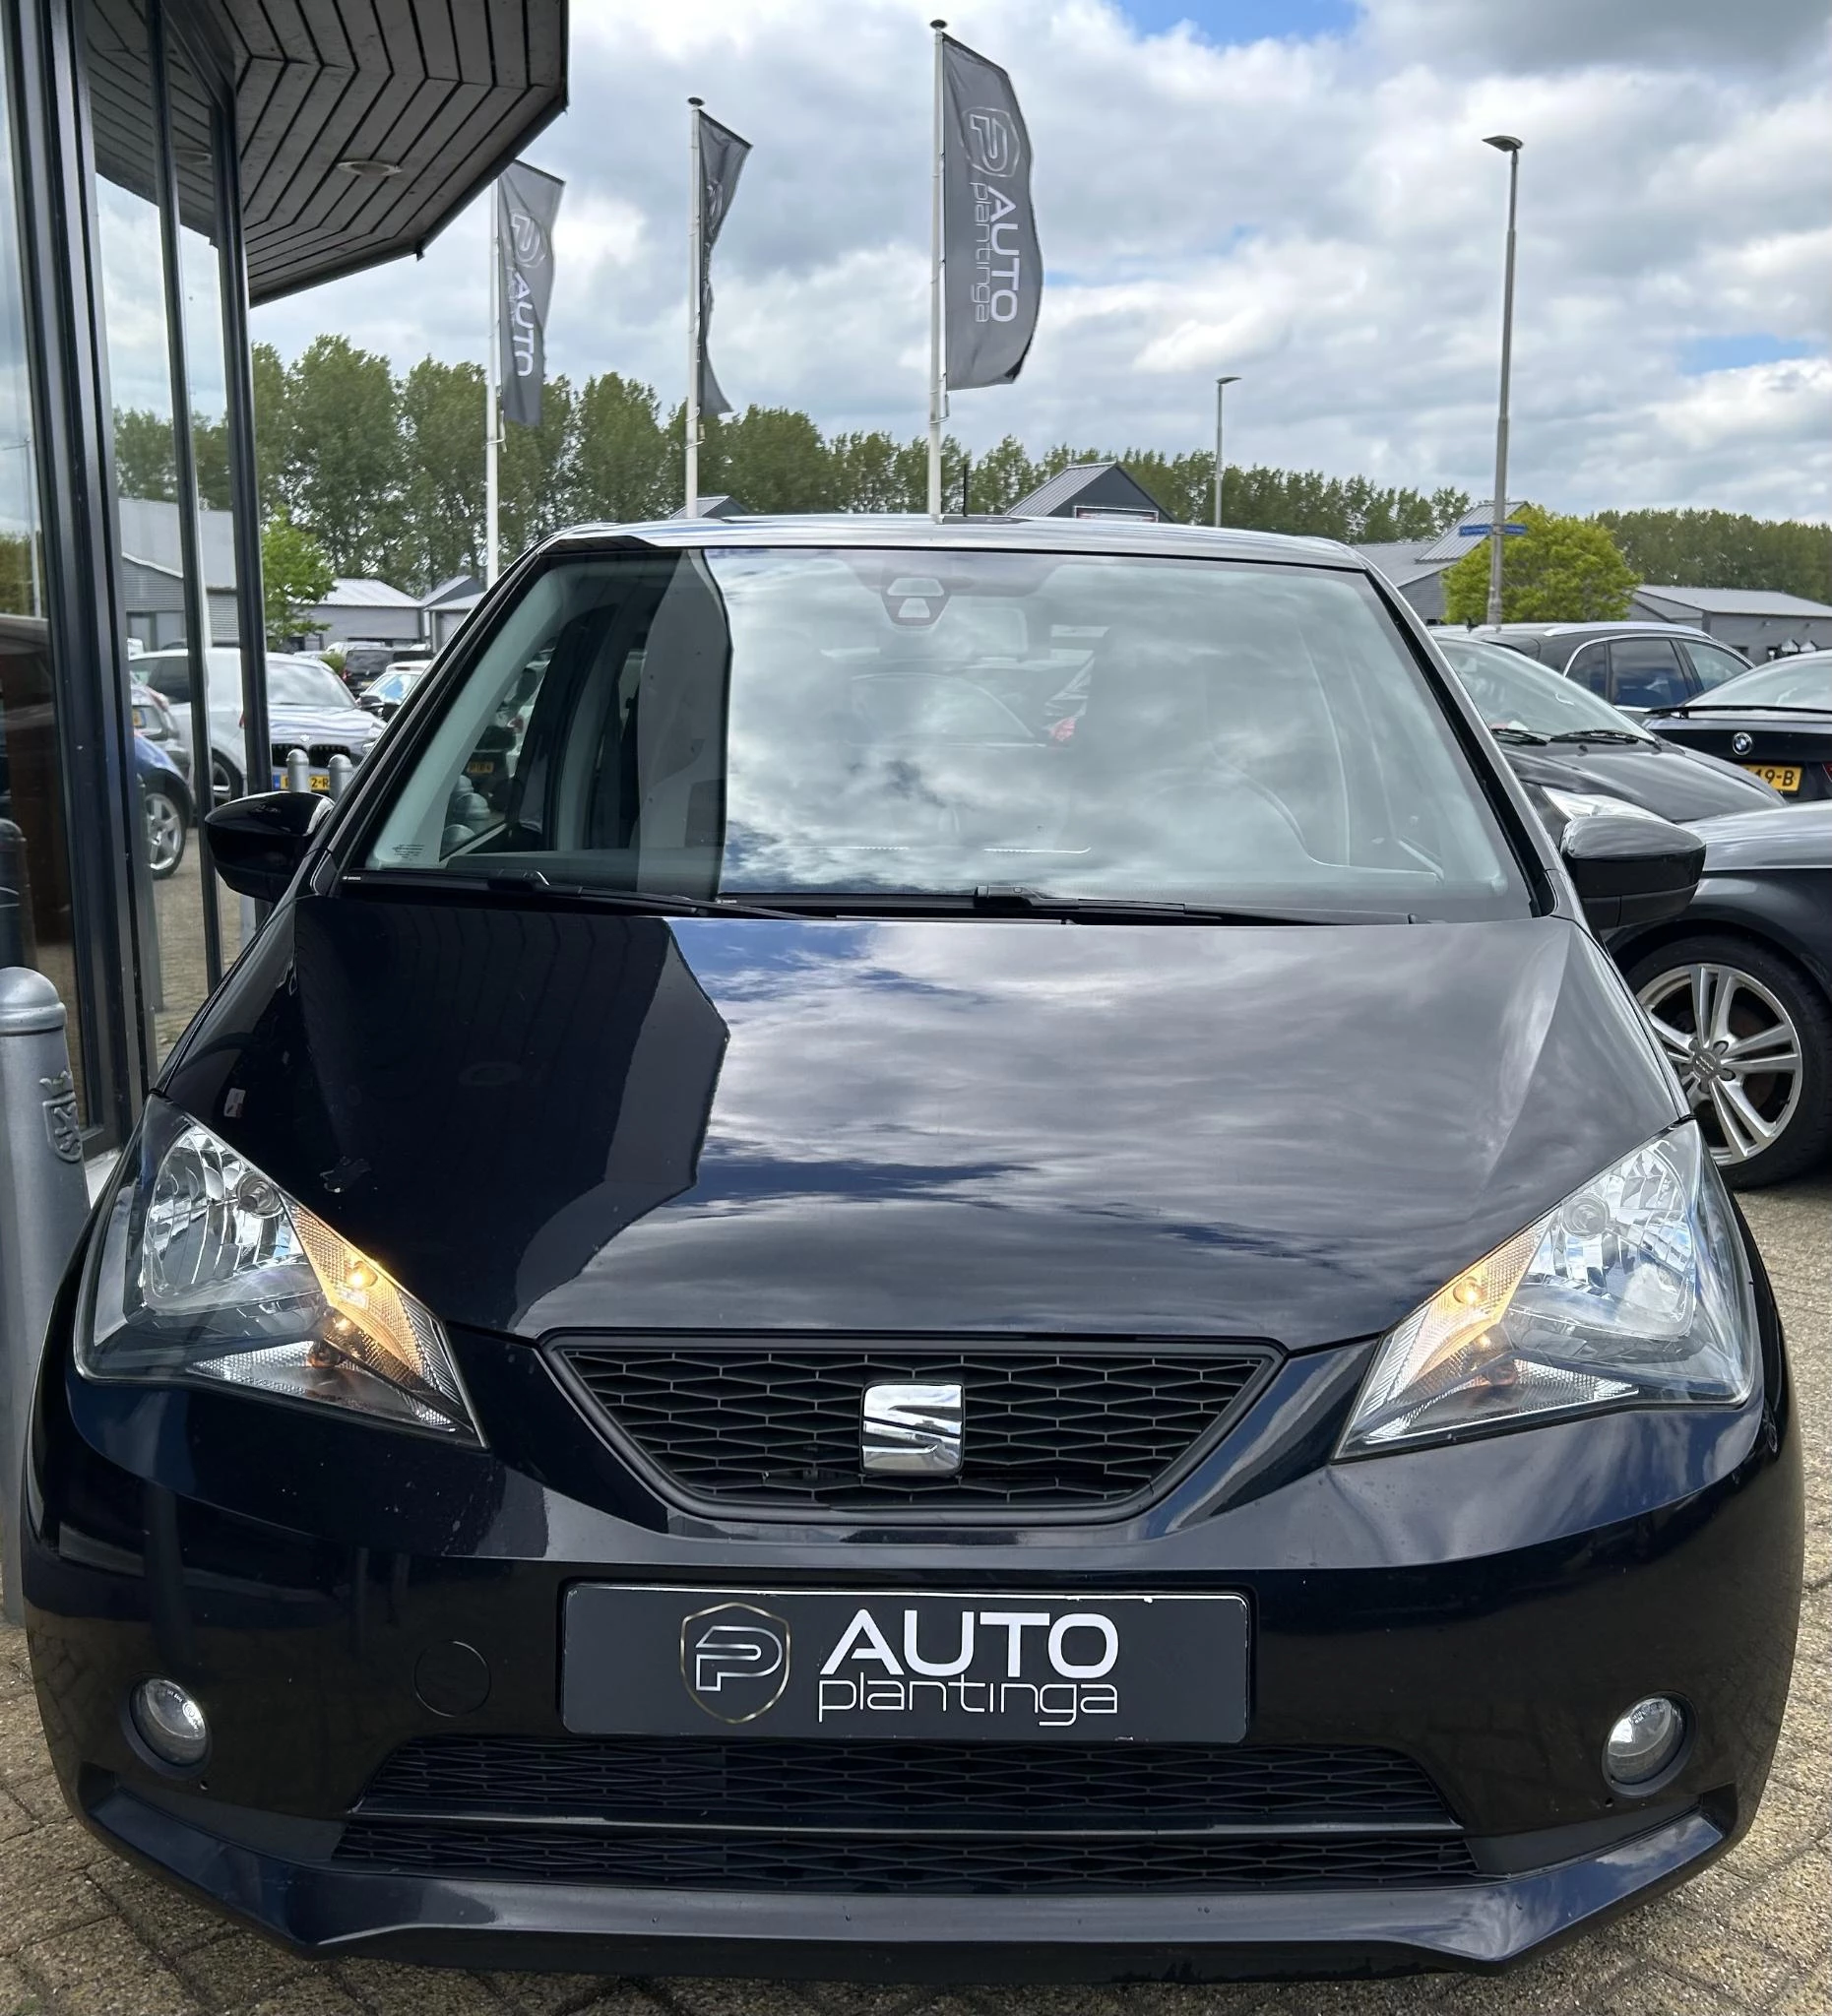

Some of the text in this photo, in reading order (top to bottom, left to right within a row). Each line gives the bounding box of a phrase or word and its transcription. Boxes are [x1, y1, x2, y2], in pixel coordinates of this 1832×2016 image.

[969, 182, 990, 323] plantinga
[987, 185, 1020, 322] AUTO
[819, 1608, 1119, 1679] AUTO
[818, 1671, 1118, 1727] plantinga
